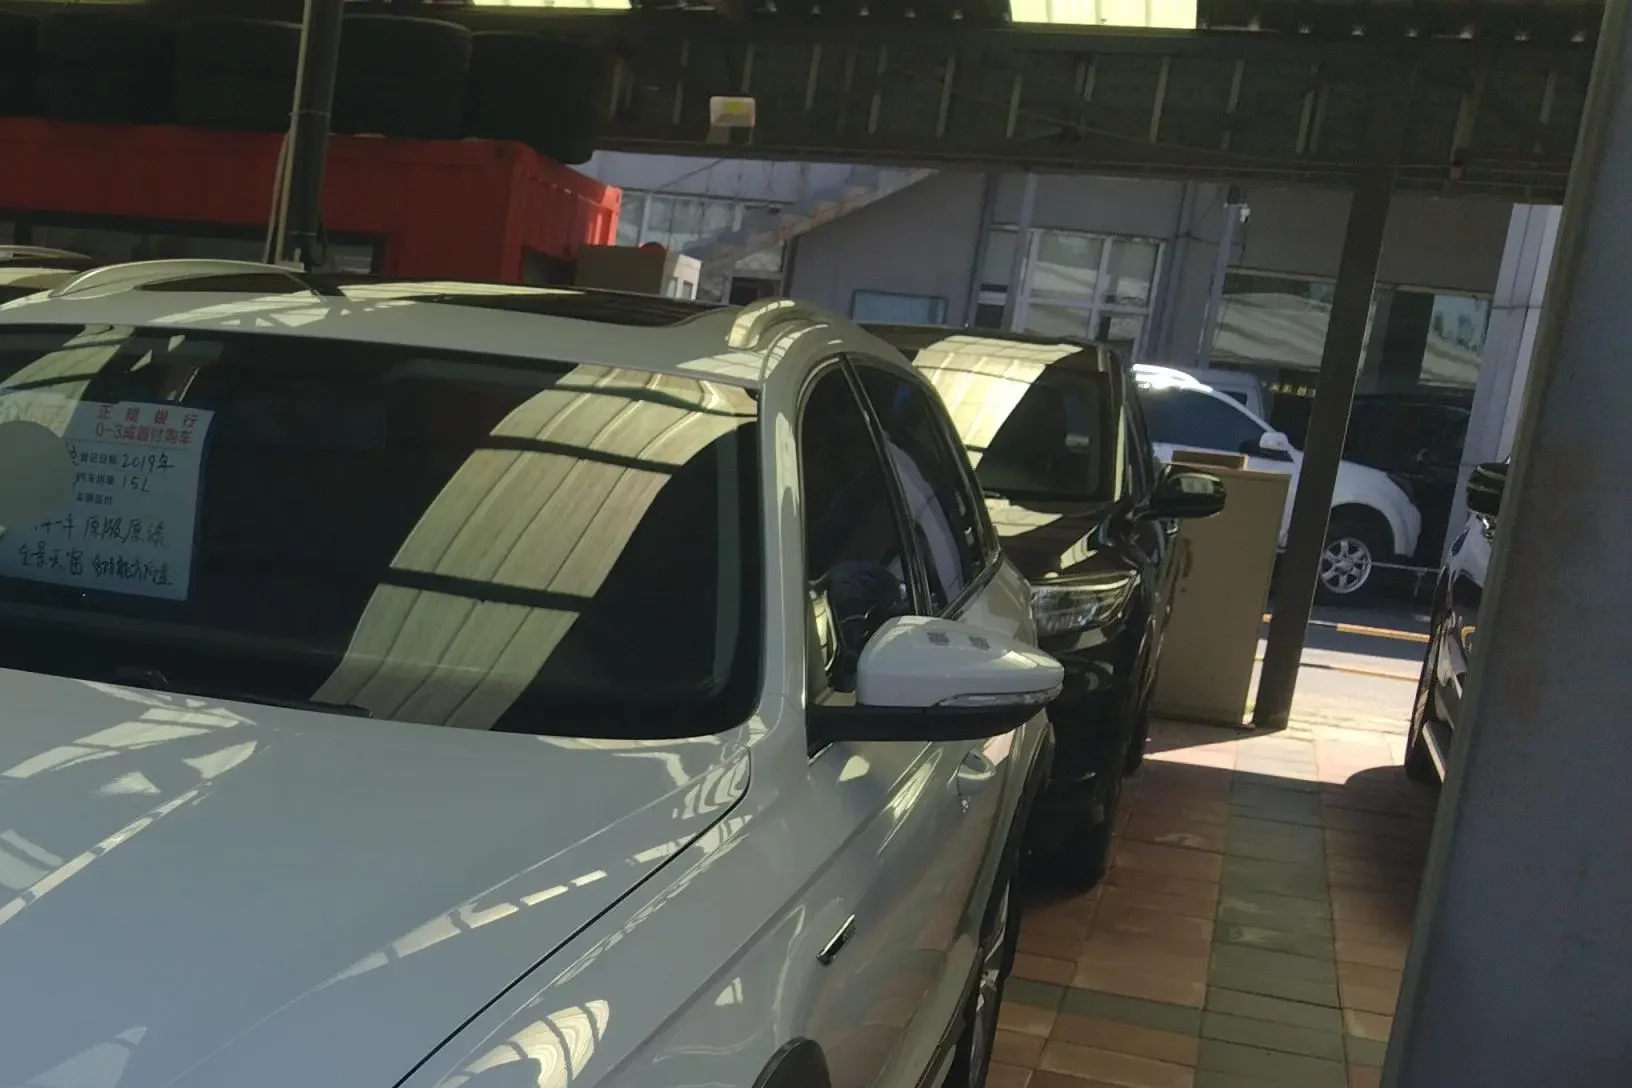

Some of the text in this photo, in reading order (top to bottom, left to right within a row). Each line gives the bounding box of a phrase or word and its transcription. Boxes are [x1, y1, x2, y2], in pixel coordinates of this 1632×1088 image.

[97, 404, 200, 429] 正规银行
[121, 451, 176, 473] 2019年
[18, 540, 85, 576] 全景天窗
